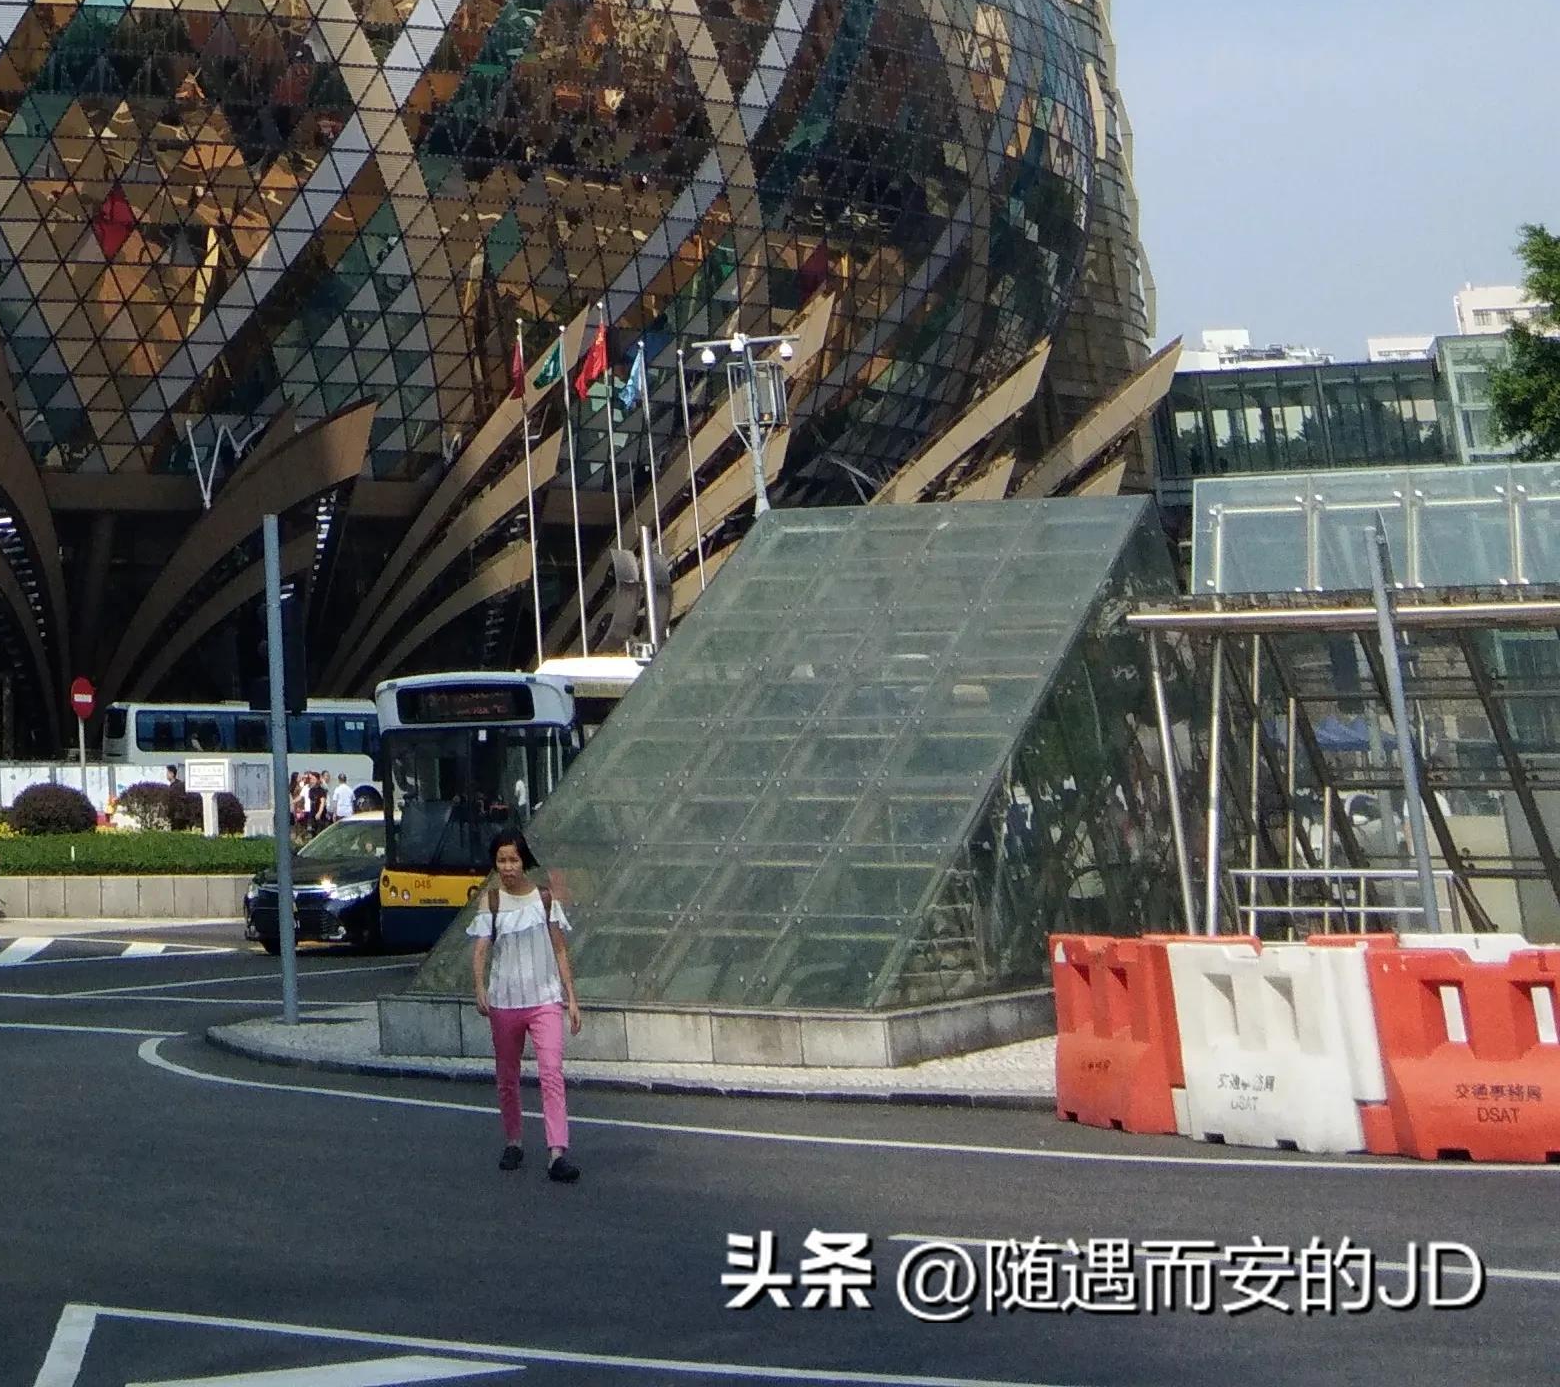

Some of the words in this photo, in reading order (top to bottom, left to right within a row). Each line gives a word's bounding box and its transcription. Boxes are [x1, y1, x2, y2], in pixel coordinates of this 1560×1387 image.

[1454, 1083, 1543, 1103] 交通事務局
[1477, 1107, 1520, 1124] DSAT
